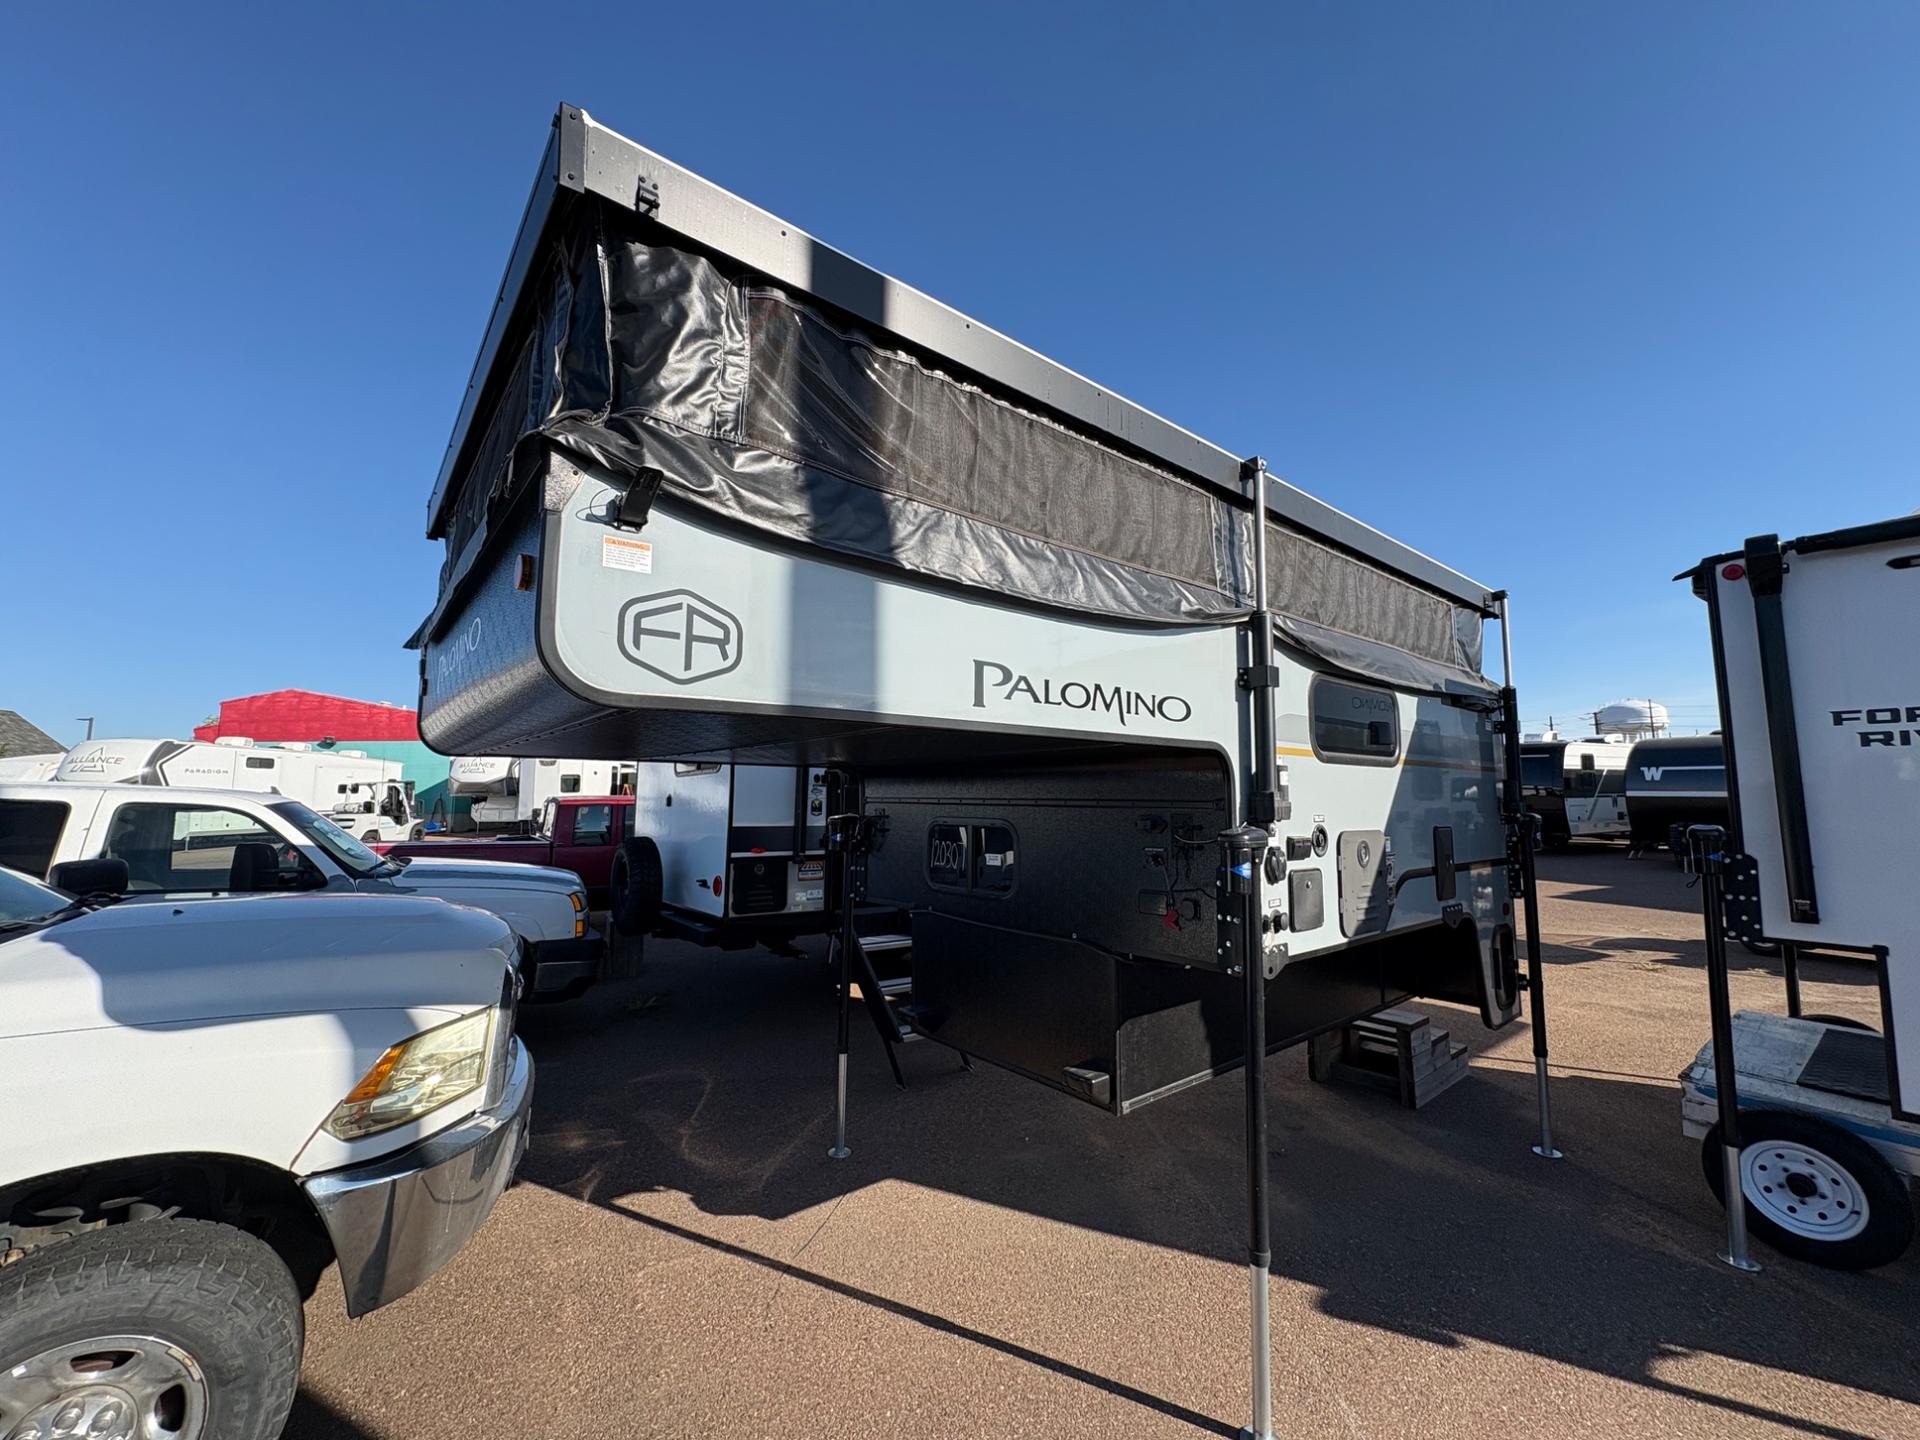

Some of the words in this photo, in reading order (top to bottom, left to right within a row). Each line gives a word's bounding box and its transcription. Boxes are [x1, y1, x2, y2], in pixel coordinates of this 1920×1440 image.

[972, 658, 1193, 727] PALOMINO
[1856, 729, 1920, 748] RI
[67, 755, 125, 766] ALLIANCE
[183, 767, 229, 775] PARADIGM
